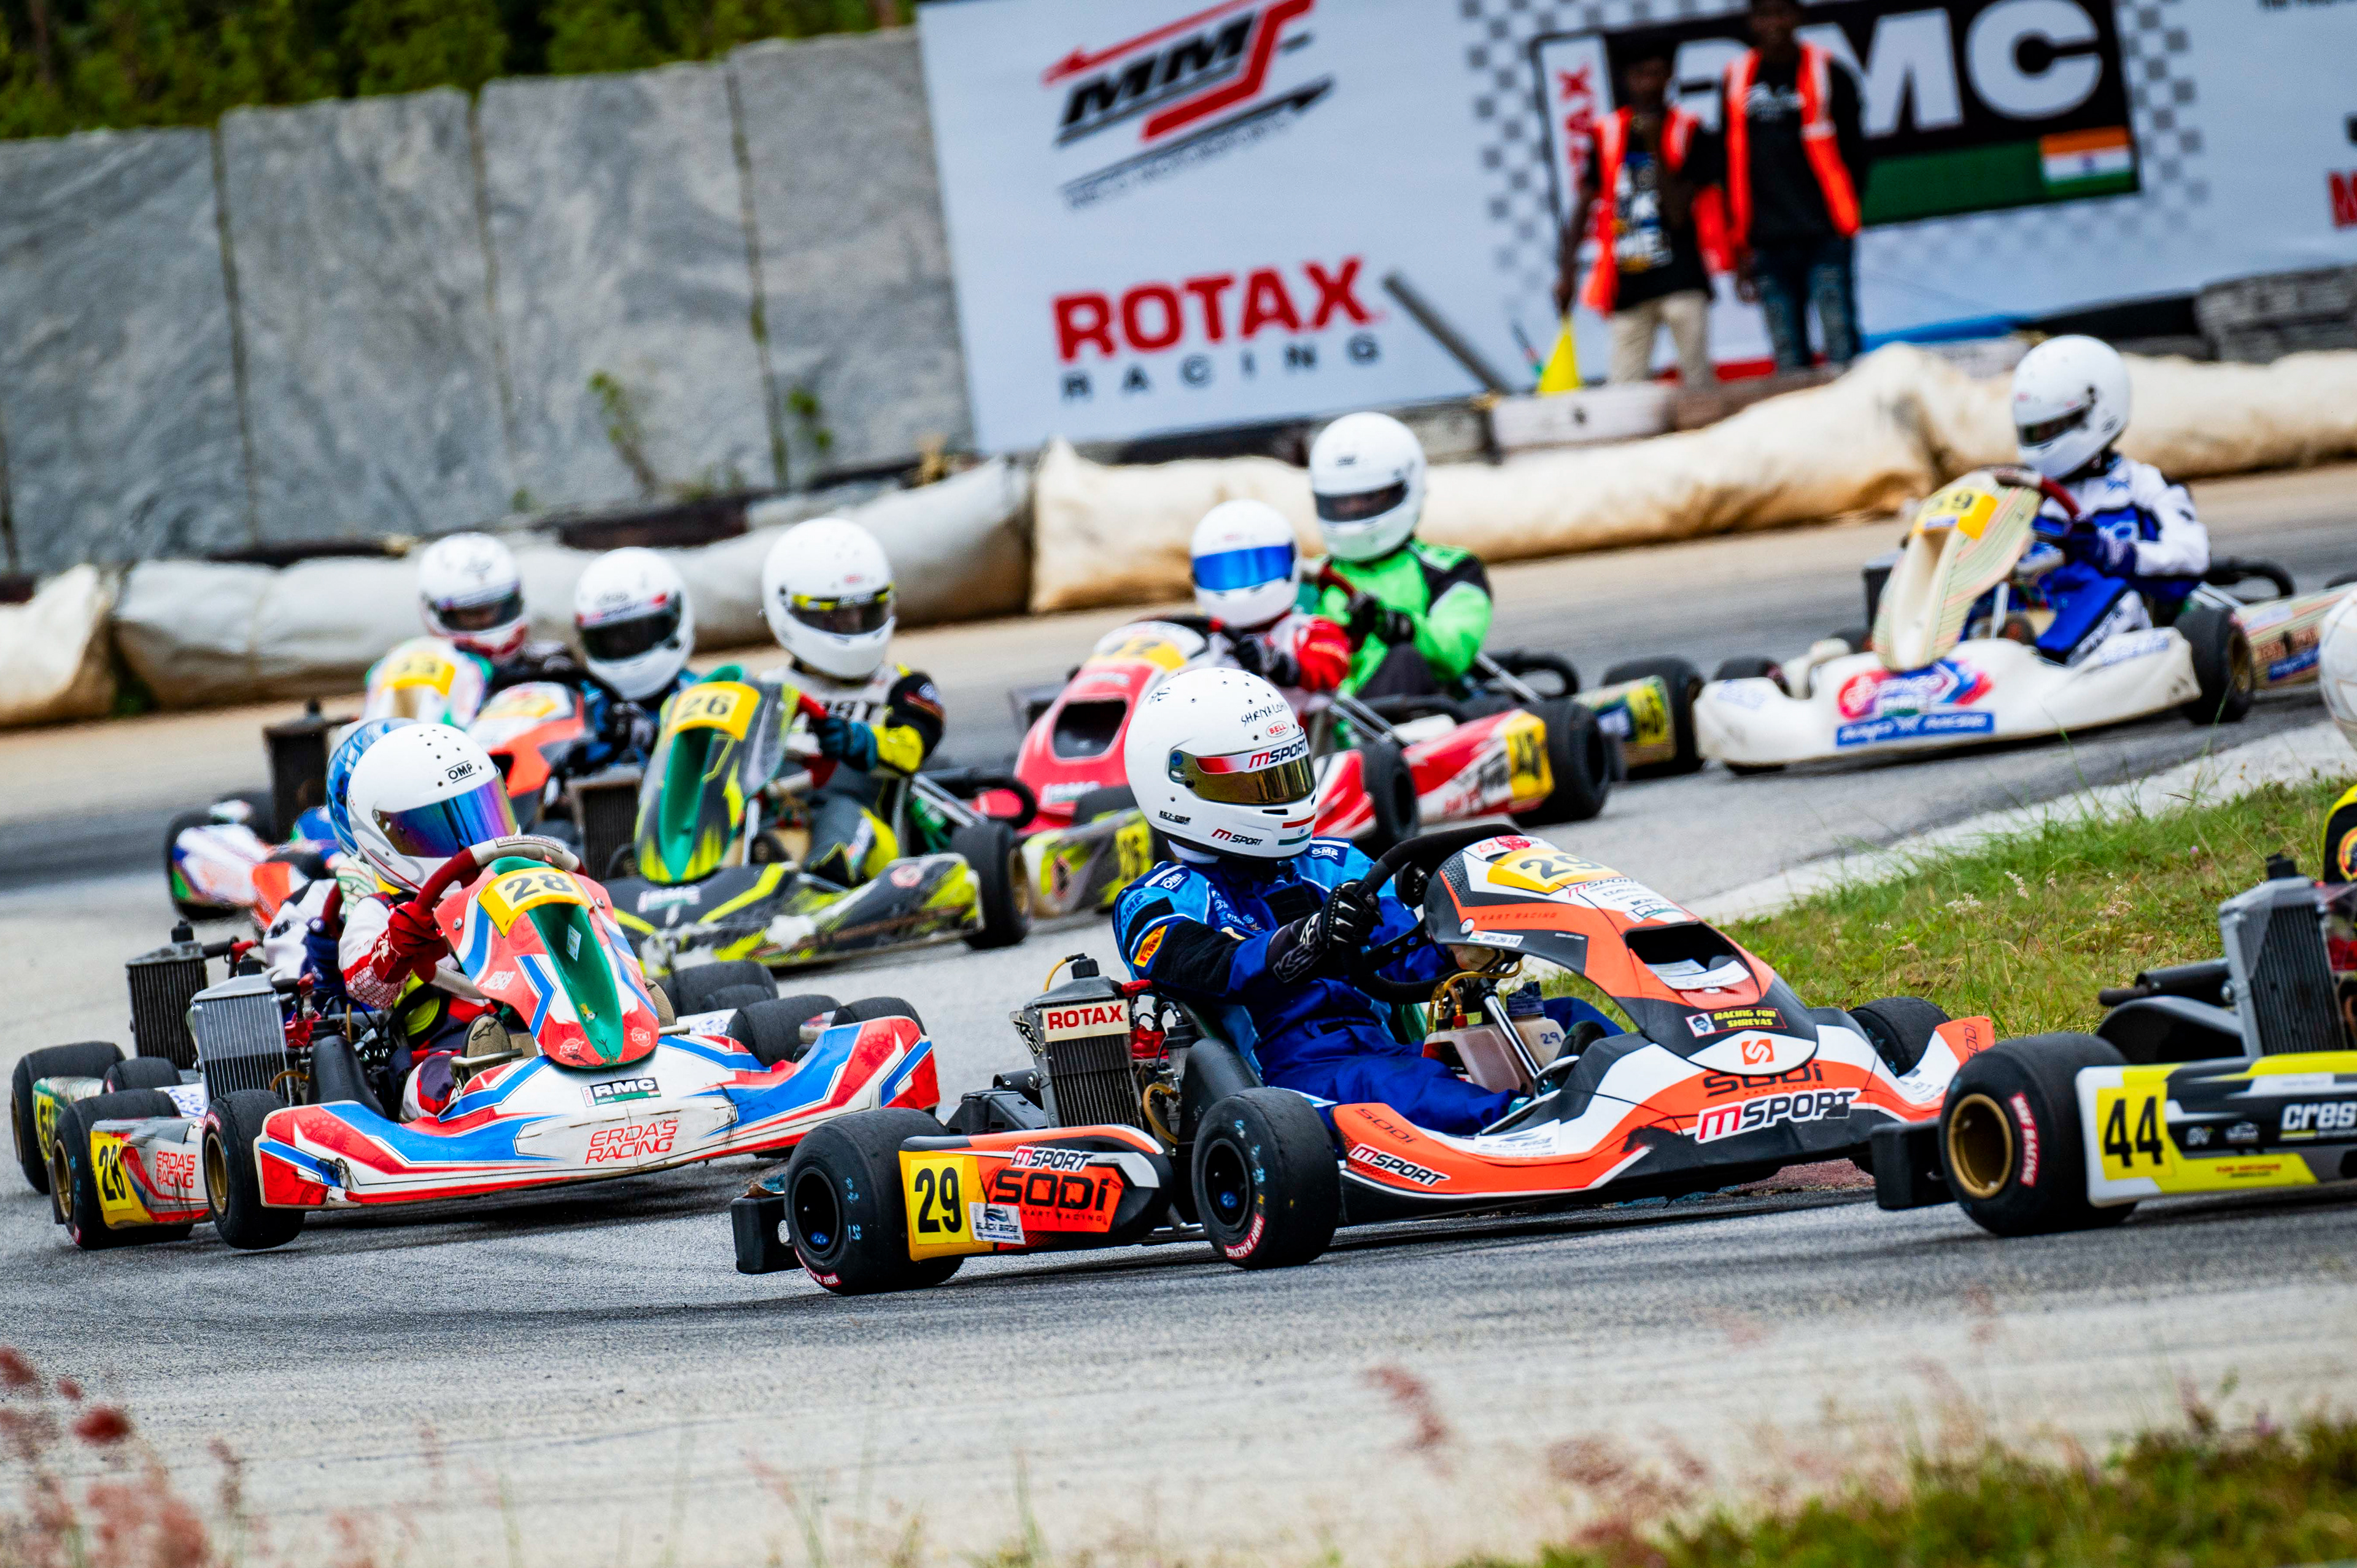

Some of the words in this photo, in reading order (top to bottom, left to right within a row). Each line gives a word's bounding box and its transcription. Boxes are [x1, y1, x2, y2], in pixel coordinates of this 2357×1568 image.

[1052, 258, 1365, 363] ROTAX
[1060, 334, 1383, 402] RACING
[679, 693, 729, 719] 26
[1268, 723, 1287, 735] BELL
[1248, 738, 1306, 768] MSPORT
[448, 763, 473, 780] OMP
[1312, 848, 1338, 857] OMP
[1520, 855, 1603, 879] 29
[505, 874, 573, 903] 28
[1162, 873, 1183, 889] OMP
[1121, 894, 1144, 929] OMP
[1047, 1005, 1123, 1030] ROTAX
[1713, 1010, 1754, 1021] RACING
[1727, 1018, 1773, 1028] SHREYAS
[1539, 1031, 1562, 1045] 29
[593, 1079, 656, 1097] RMC
[1698, 1090, 1857, 1140] MSPORT
[589, 1119, 678, 1148] ERDA'S
[2104, 1095, 2164, 1168] 44
[155, 1150, 196, 1171] ERDA'S
[584, 1135, 675, 1165] RACING
[1011, 1148, 1094, 1172] MSPORT
[98, 1144, 126, 1202] 28
[1351, 1146, 1447, 1186] MSPORT
[155, 1168, 195, 1189] RACING
[914, 1166, 962, 1234] 29
[1022, 1210, 1051, 1218] KART
[1225, 1238, 1254, 1259] RACING
